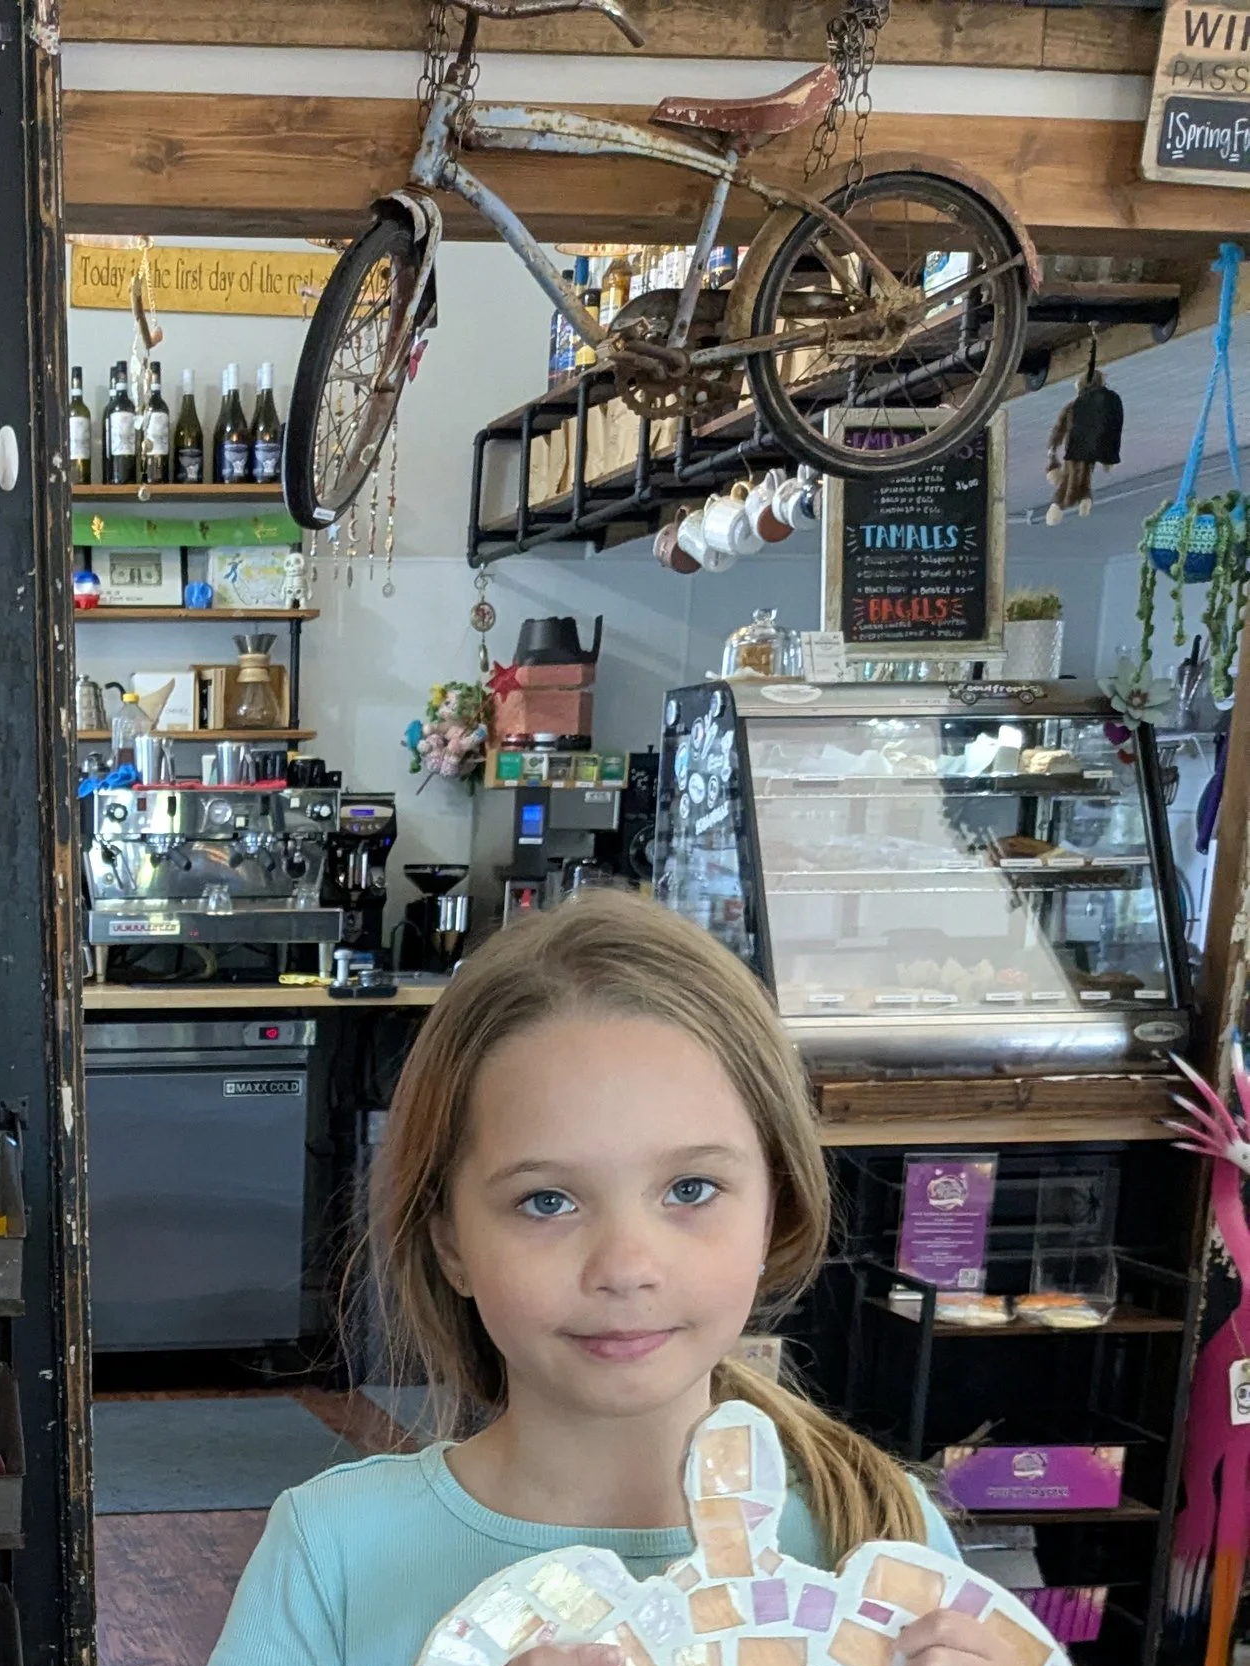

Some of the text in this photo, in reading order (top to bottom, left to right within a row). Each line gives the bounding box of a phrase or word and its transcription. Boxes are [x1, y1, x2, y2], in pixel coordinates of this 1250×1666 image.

[81, 255, 126, 298] Today
[175, 253, 201, 291] first
[208, 261, 233, 301] day
[239, 260, 258, 293] of
[260, 263, 283, 294] the
[860, 524, 959, 550] TAMALES
[869, 597, 948, 623] BAGELS
[236, 1082, 299, 1093] MAXX COLD
